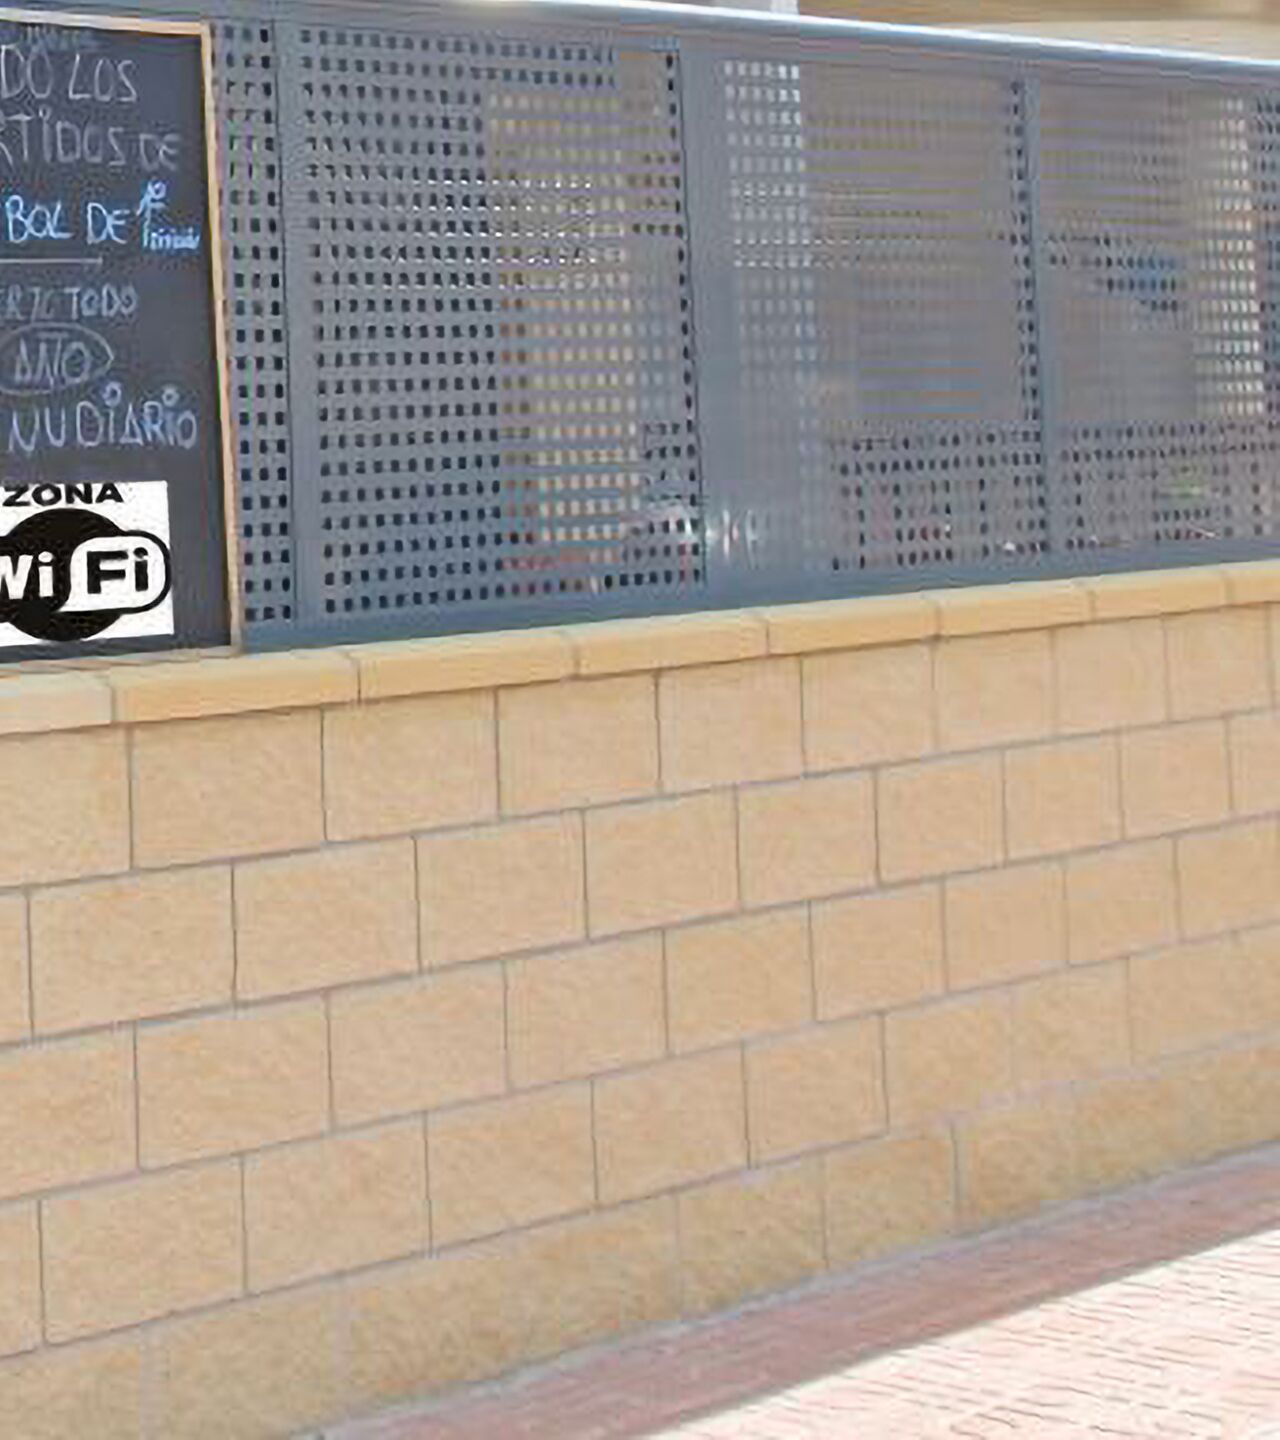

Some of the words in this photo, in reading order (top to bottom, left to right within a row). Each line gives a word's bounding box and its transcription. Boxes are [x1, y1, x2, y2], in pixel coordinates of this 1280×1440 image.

[68, 52, 138, 102] LOS
[86, 201, 132, 245] DE
[1, 481, 125, 508] ZONA
